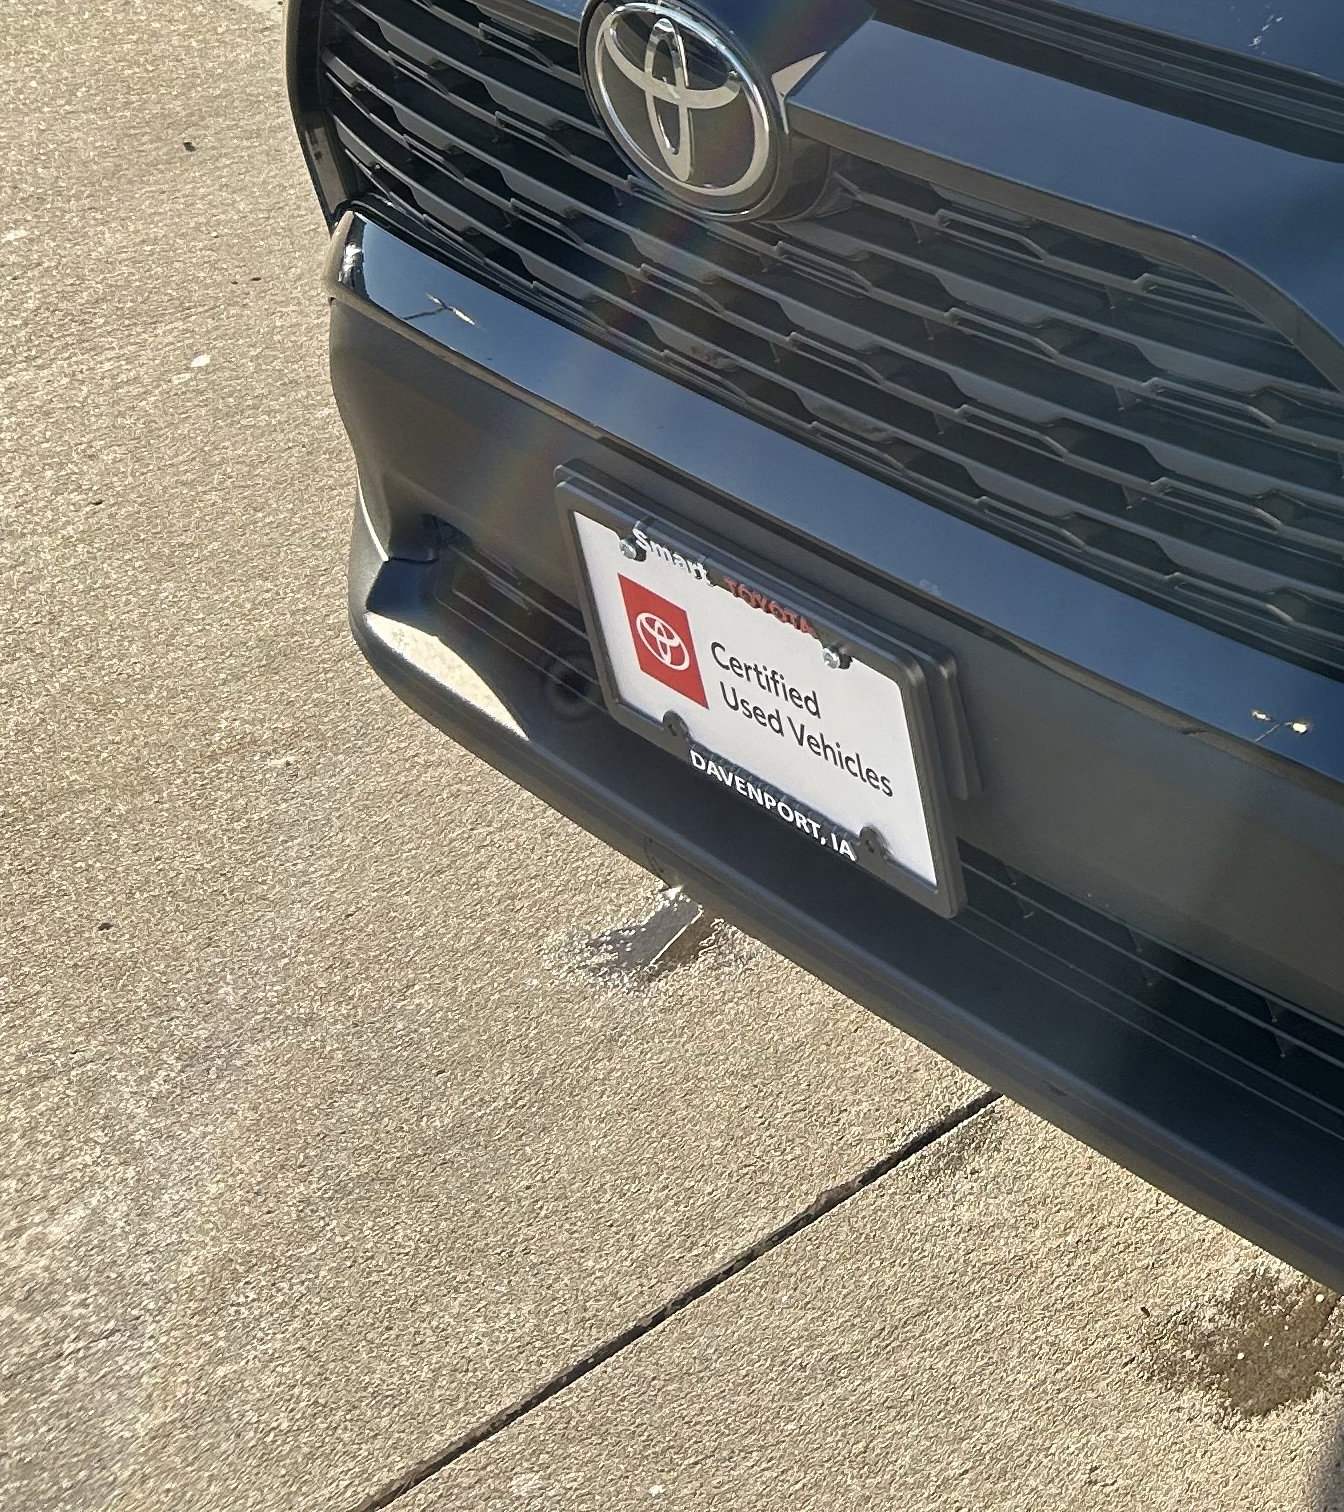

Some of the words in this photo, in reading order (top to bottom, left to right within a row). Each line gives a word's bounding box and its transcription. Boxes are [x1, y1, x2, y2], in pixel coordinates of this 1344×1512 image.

[632, 527, 711, 585] Smart
[710, 641, 821, 719] Certified
[719, 680, 785, 738] Used
[787, 715, 894, 798] Vehicles
[689, 749, 828, 846] DAVENPORT,
[832, 831, 859, 862] IA
